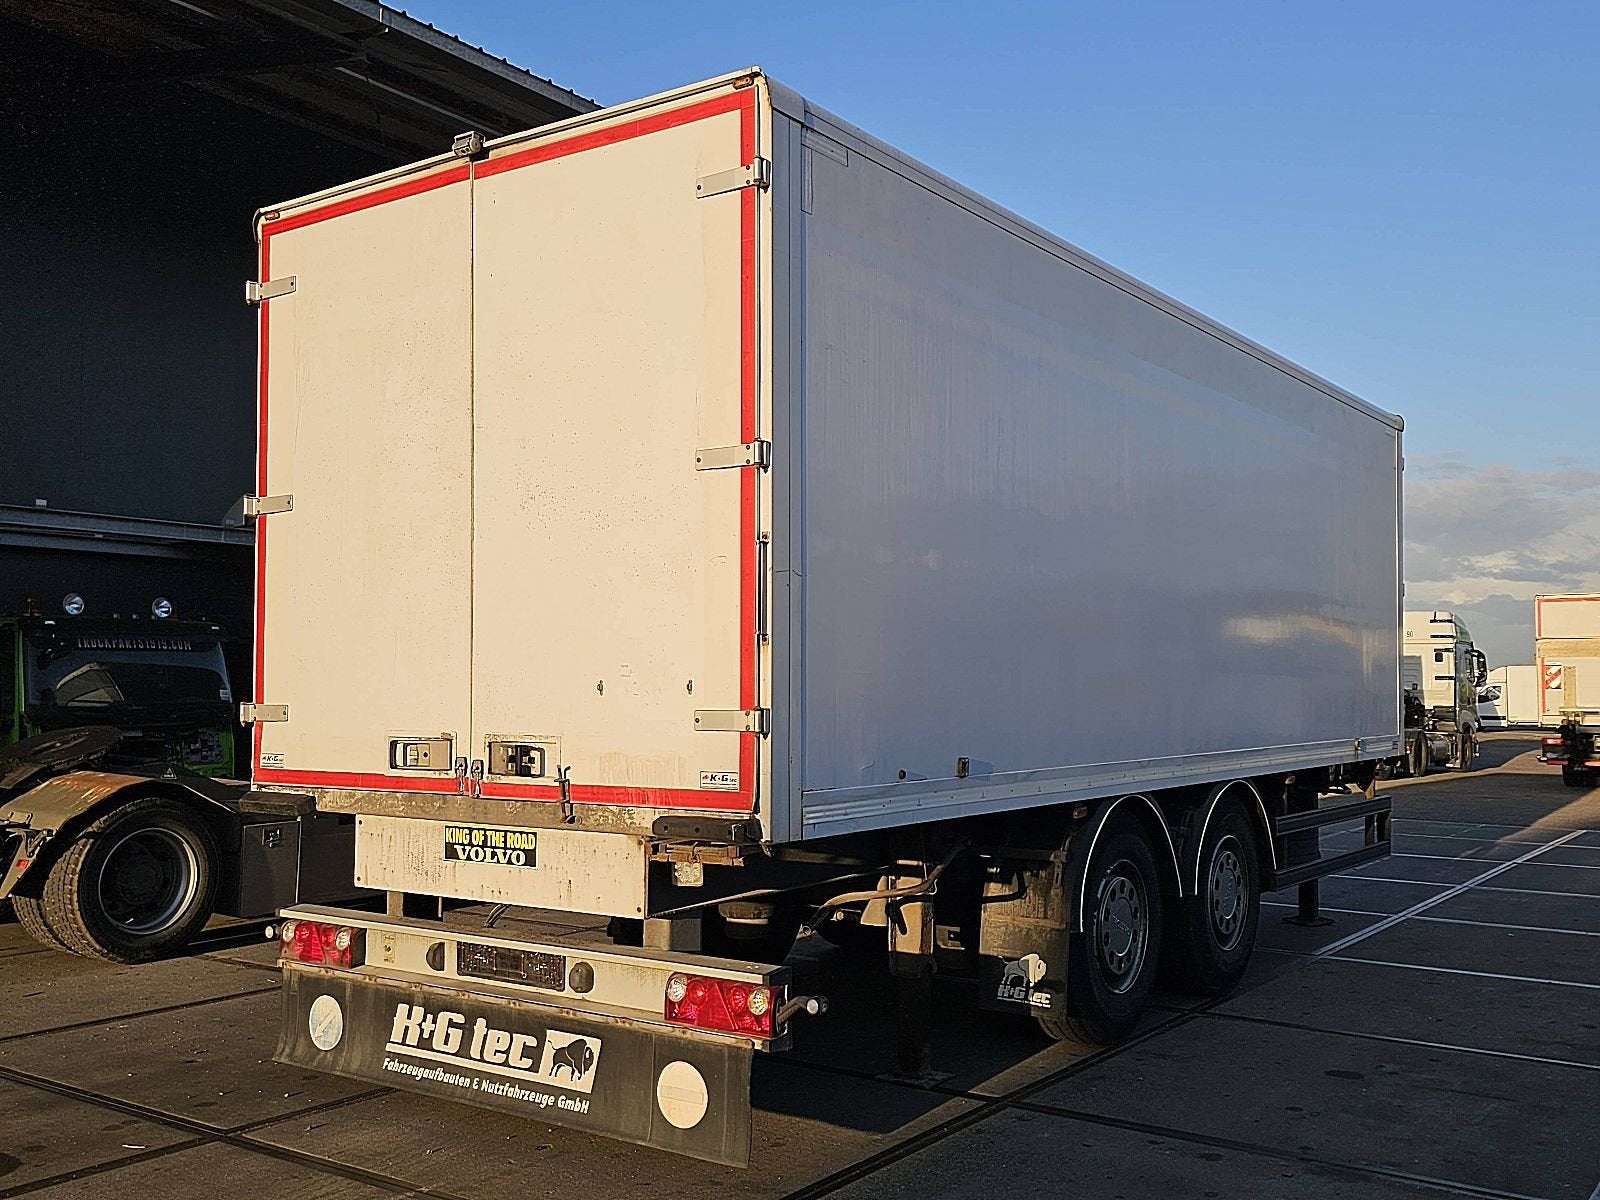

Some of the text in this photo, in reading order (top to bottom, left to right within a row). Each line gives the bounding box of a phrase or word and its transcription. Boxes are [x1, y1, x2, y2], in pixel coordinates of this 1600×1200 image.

[445, 827, 536, 850] KING OF THE ROAD
[454, 844, 526, 866] VOLVO
[389, 1003, 539, 1069] K+G tec
[382, 1057, 590, 1114] Fahrzeugaufbauten & Nutzfahrzeuge GmbH
